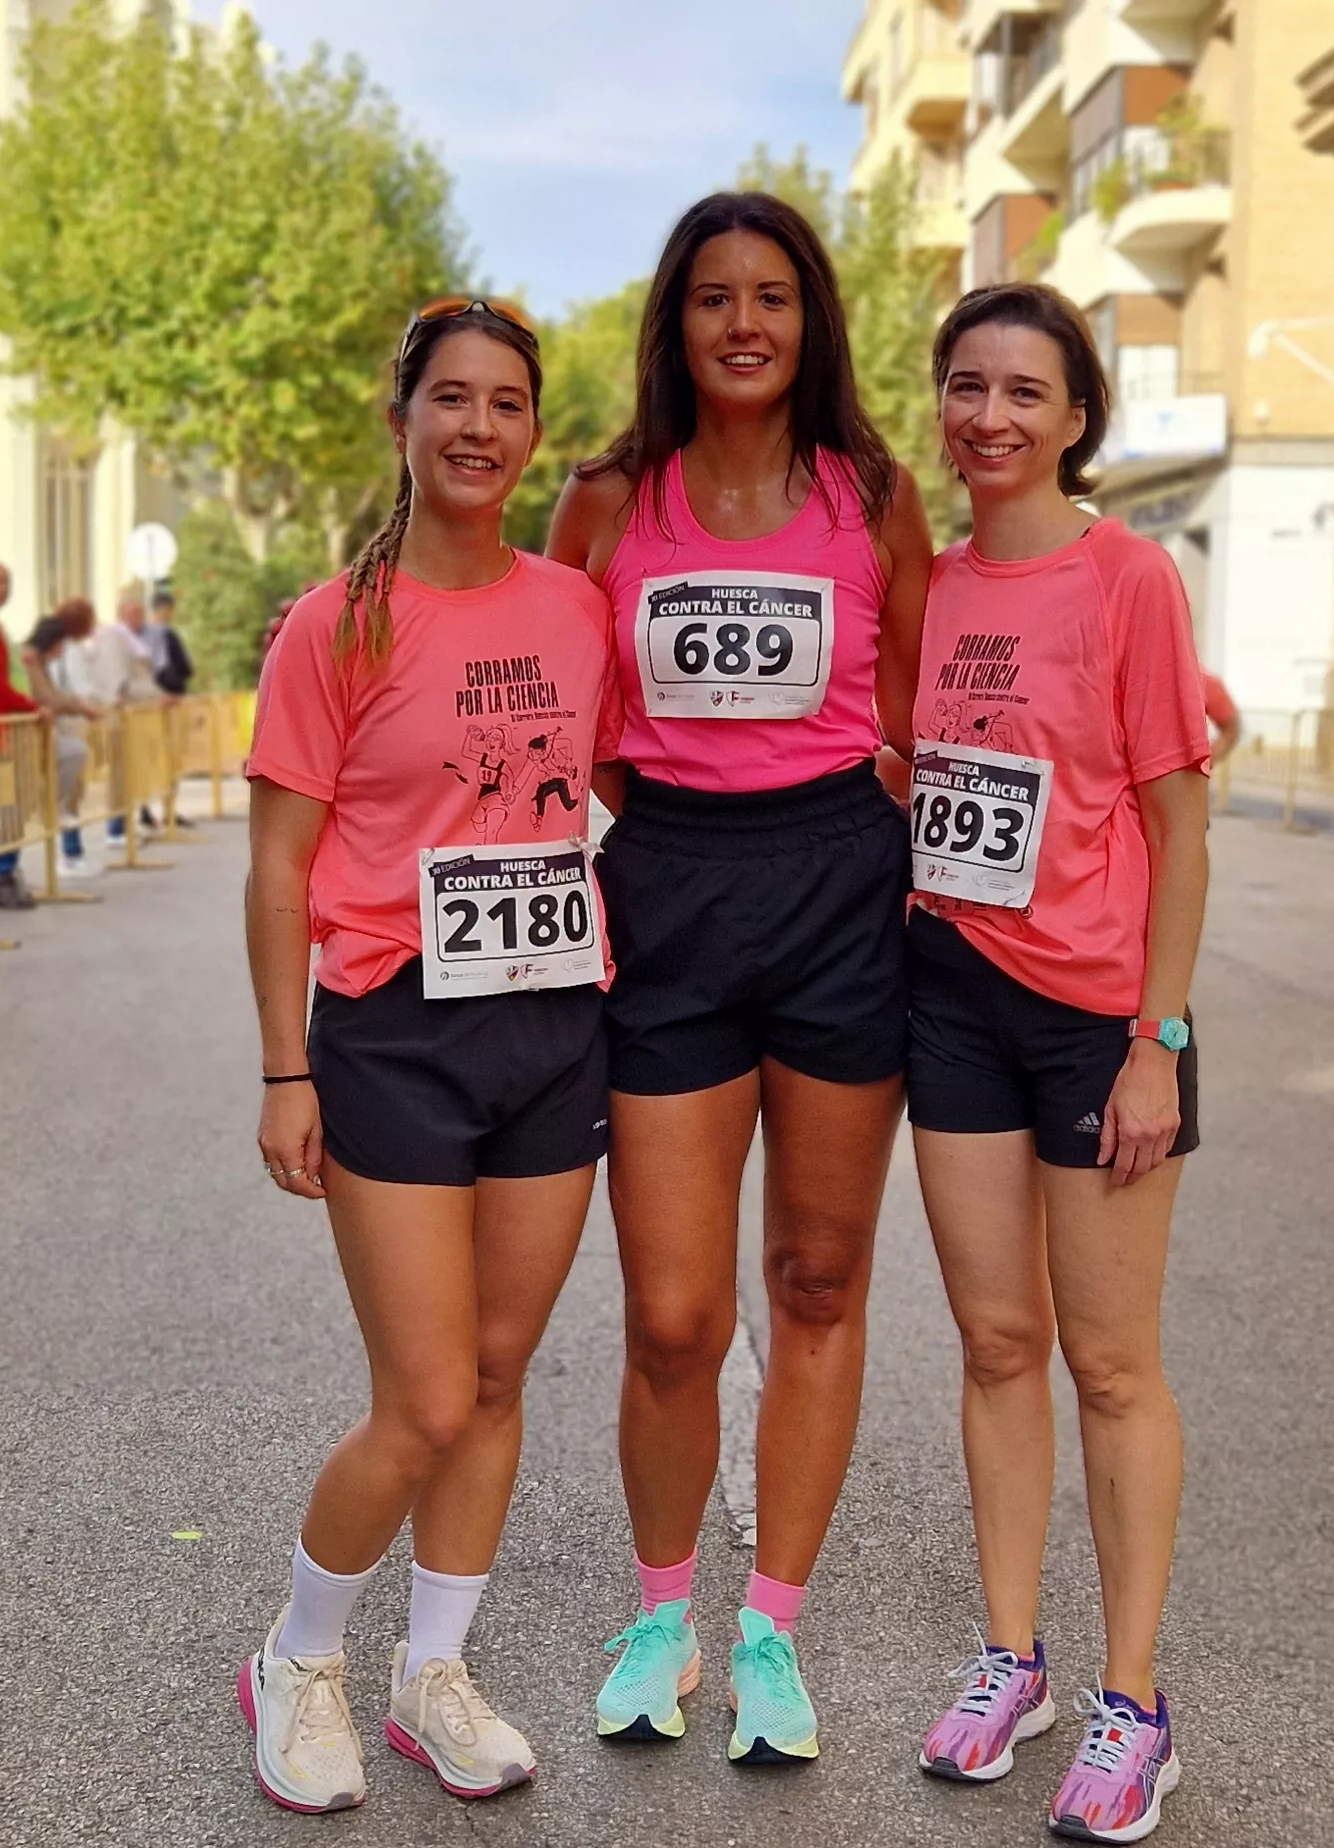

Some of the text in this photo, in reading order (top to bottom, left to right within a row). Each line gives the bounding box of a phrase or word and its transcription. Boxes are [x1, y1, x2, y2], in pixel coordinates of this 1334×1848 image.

[711, 588, 759, 600] HUESCA
[659, 599, 813, 618] CONTRA EL CÁNCER
[673, 622, 794, 677] 689
[952, 633, 1022, 661] CORRAMOS
[465, 654, 542, 688] CORRAMOS
[934, 662, 1021, 691] POR LA CIENCIA
[455, 681, 559, 718] POR LA CIENCIA
[947, 761, 981, 777] HUESCA
[916, 768, 1029, 801] CONTRA EL CÁNCER
[913, 792, 1025, 862] 1893
[444, 866, 582, 891] CONTRA EL CÁNCER
[500, 859, 547, 872] HUESCA
[442, 890, 588, 954] 2180
[1073, 1124, 1100, 1134] adida
